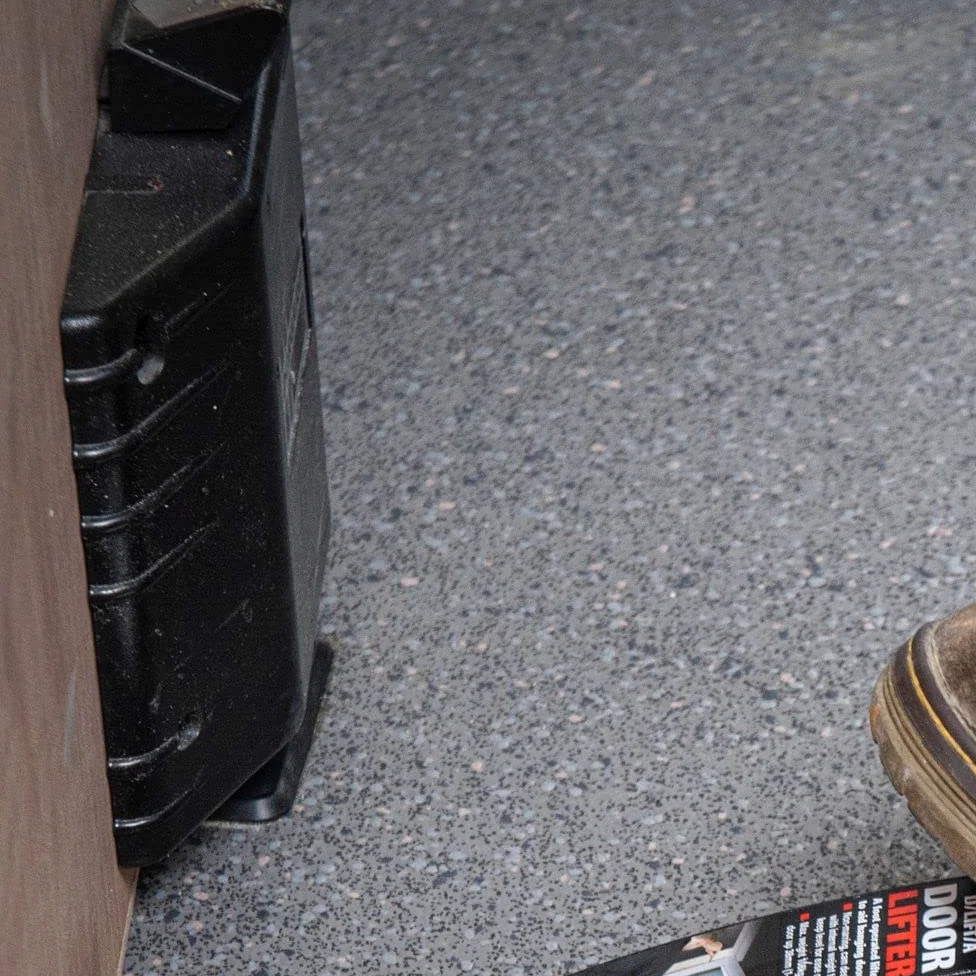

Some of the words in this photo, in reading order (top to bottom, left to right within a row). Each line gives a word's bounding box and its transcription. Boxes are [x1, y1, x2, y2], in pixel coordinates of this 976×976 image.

[858, 900, 867, 909] to
[829, 914, 839, 928] with
[858, 910, 868, 923] aid
[871, 905, 882, 923] foot
[786, 925, 795, 939] door
[799, 922, 809, 937] Max.
[814, 917, 826, 933] keep
[921, 883, 958, 974] DOOR
[783, 941, 793, 949] up
[796, 937, 808, 958] weight
[815, 933, 825, 948] level
[828, 928, 838, 952] internal
[854, 924, 867, 958] hanging
[869, 923, 880, 960] operated
[815, 948, 824, 957] for
[840, 951, 848, 965] cam
[814, 958, 822, 974] ease
[825, 952, 837, 973] weight
